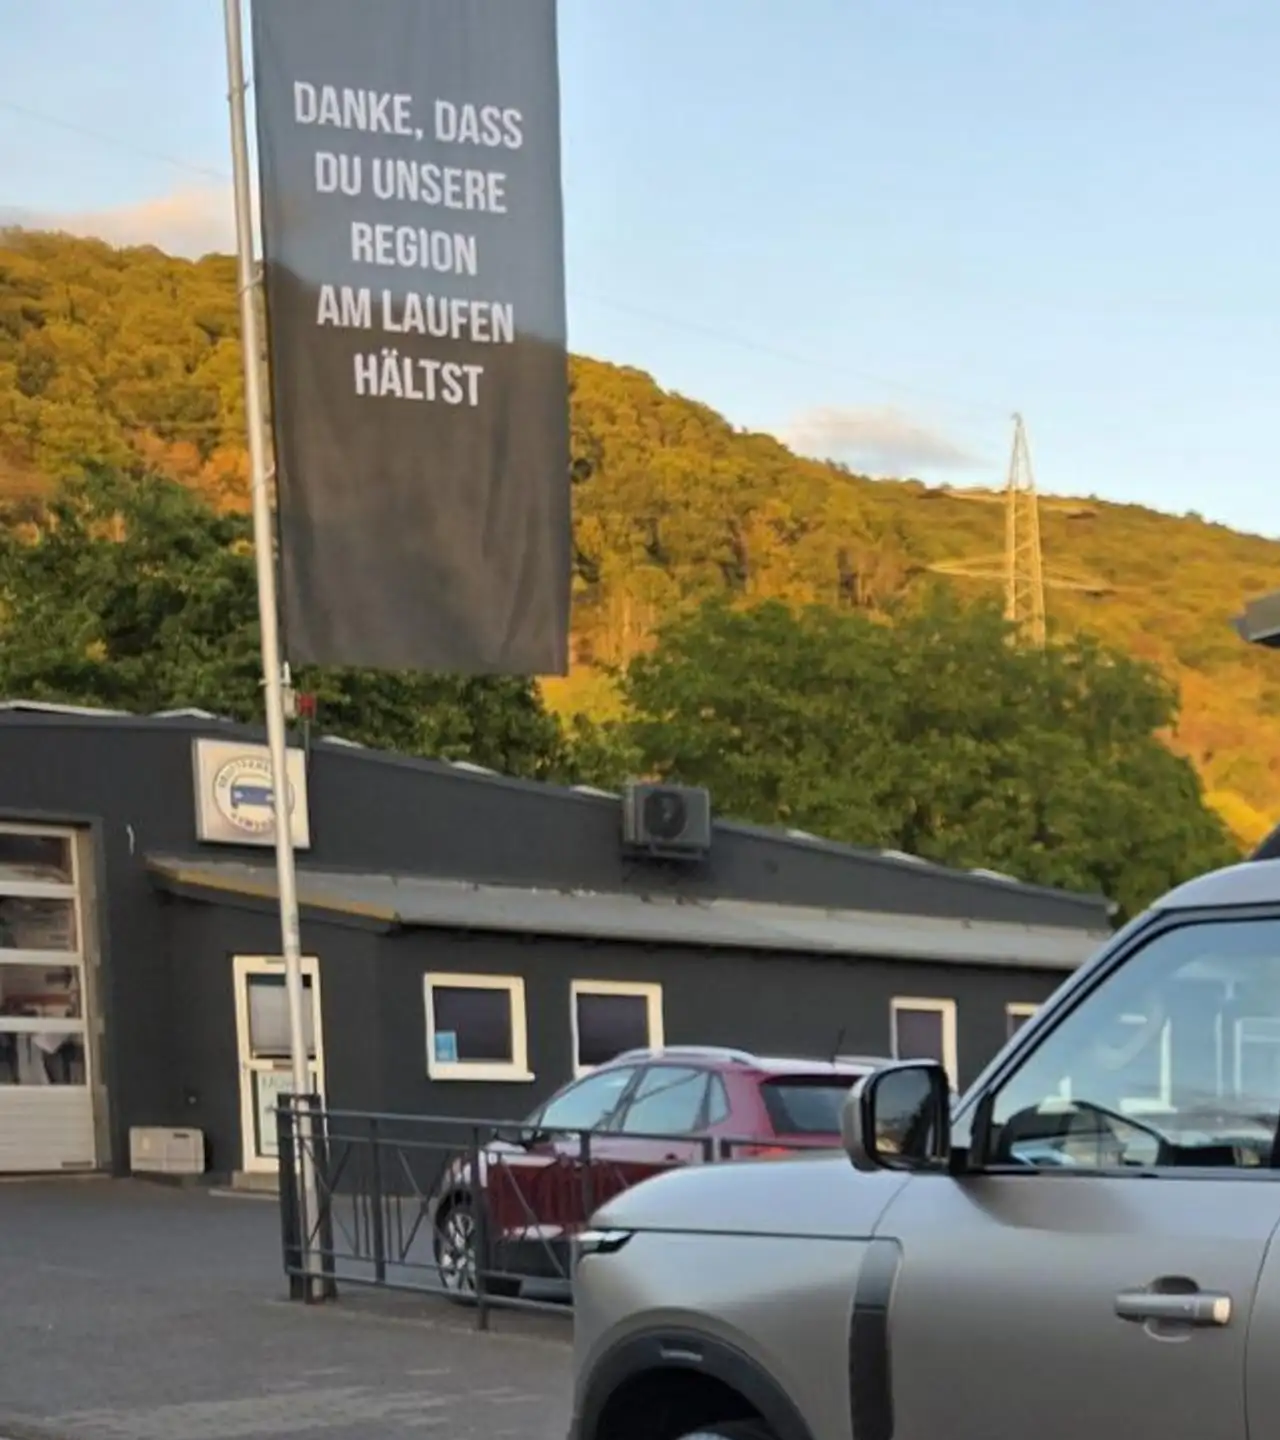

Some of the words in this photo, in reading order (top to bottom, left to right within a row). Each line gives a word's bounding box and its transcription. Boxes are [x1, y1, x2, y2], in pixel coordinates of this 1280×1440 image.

[294, 80, 424, 141] DANKE,
[435, 98, 523, 149] DASS
[315, 151, 363, 196] DU
[372, 157, 508, 213] UNSERE
[351, 221, 478, 276] REGION
[316, 284, 372, 329] AM
[382, 288, 514, 344] LAUFEN
[353, 347, 484, 406] HÄLTST
